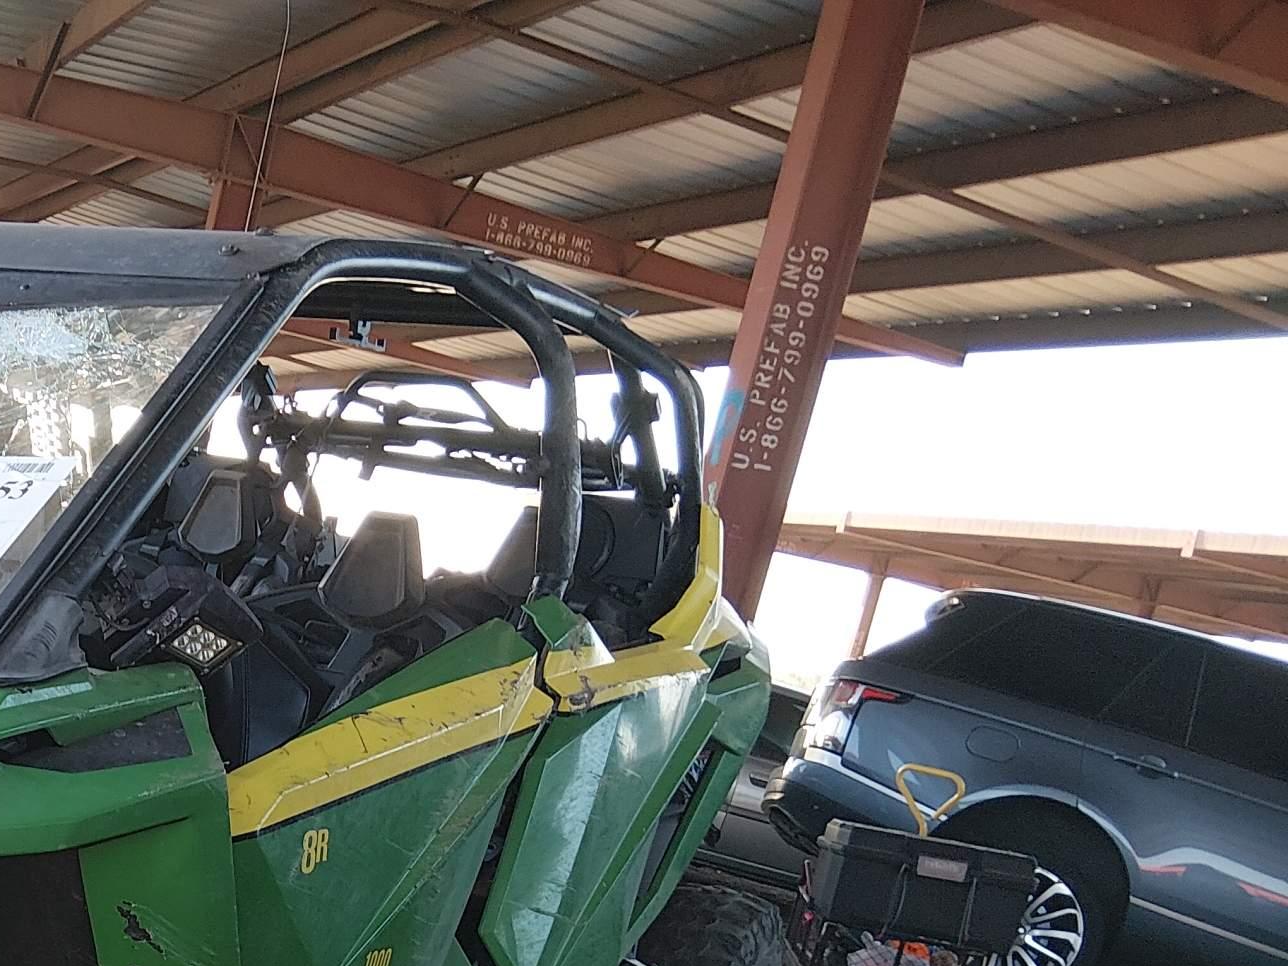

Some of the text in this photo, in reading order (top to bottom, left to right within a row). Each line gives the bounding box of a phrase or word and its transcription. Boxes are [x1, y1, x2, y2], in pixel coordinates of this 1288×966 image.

[517, 220, 567, 246] PREFAB
[571, 234, 594, 254] INC.
[731, 239, 809, 470] U.S. PREFAB INC.
[754, 246, 830, 471] 1-866-799-0969
[300, 828, 329, 875] 8R
